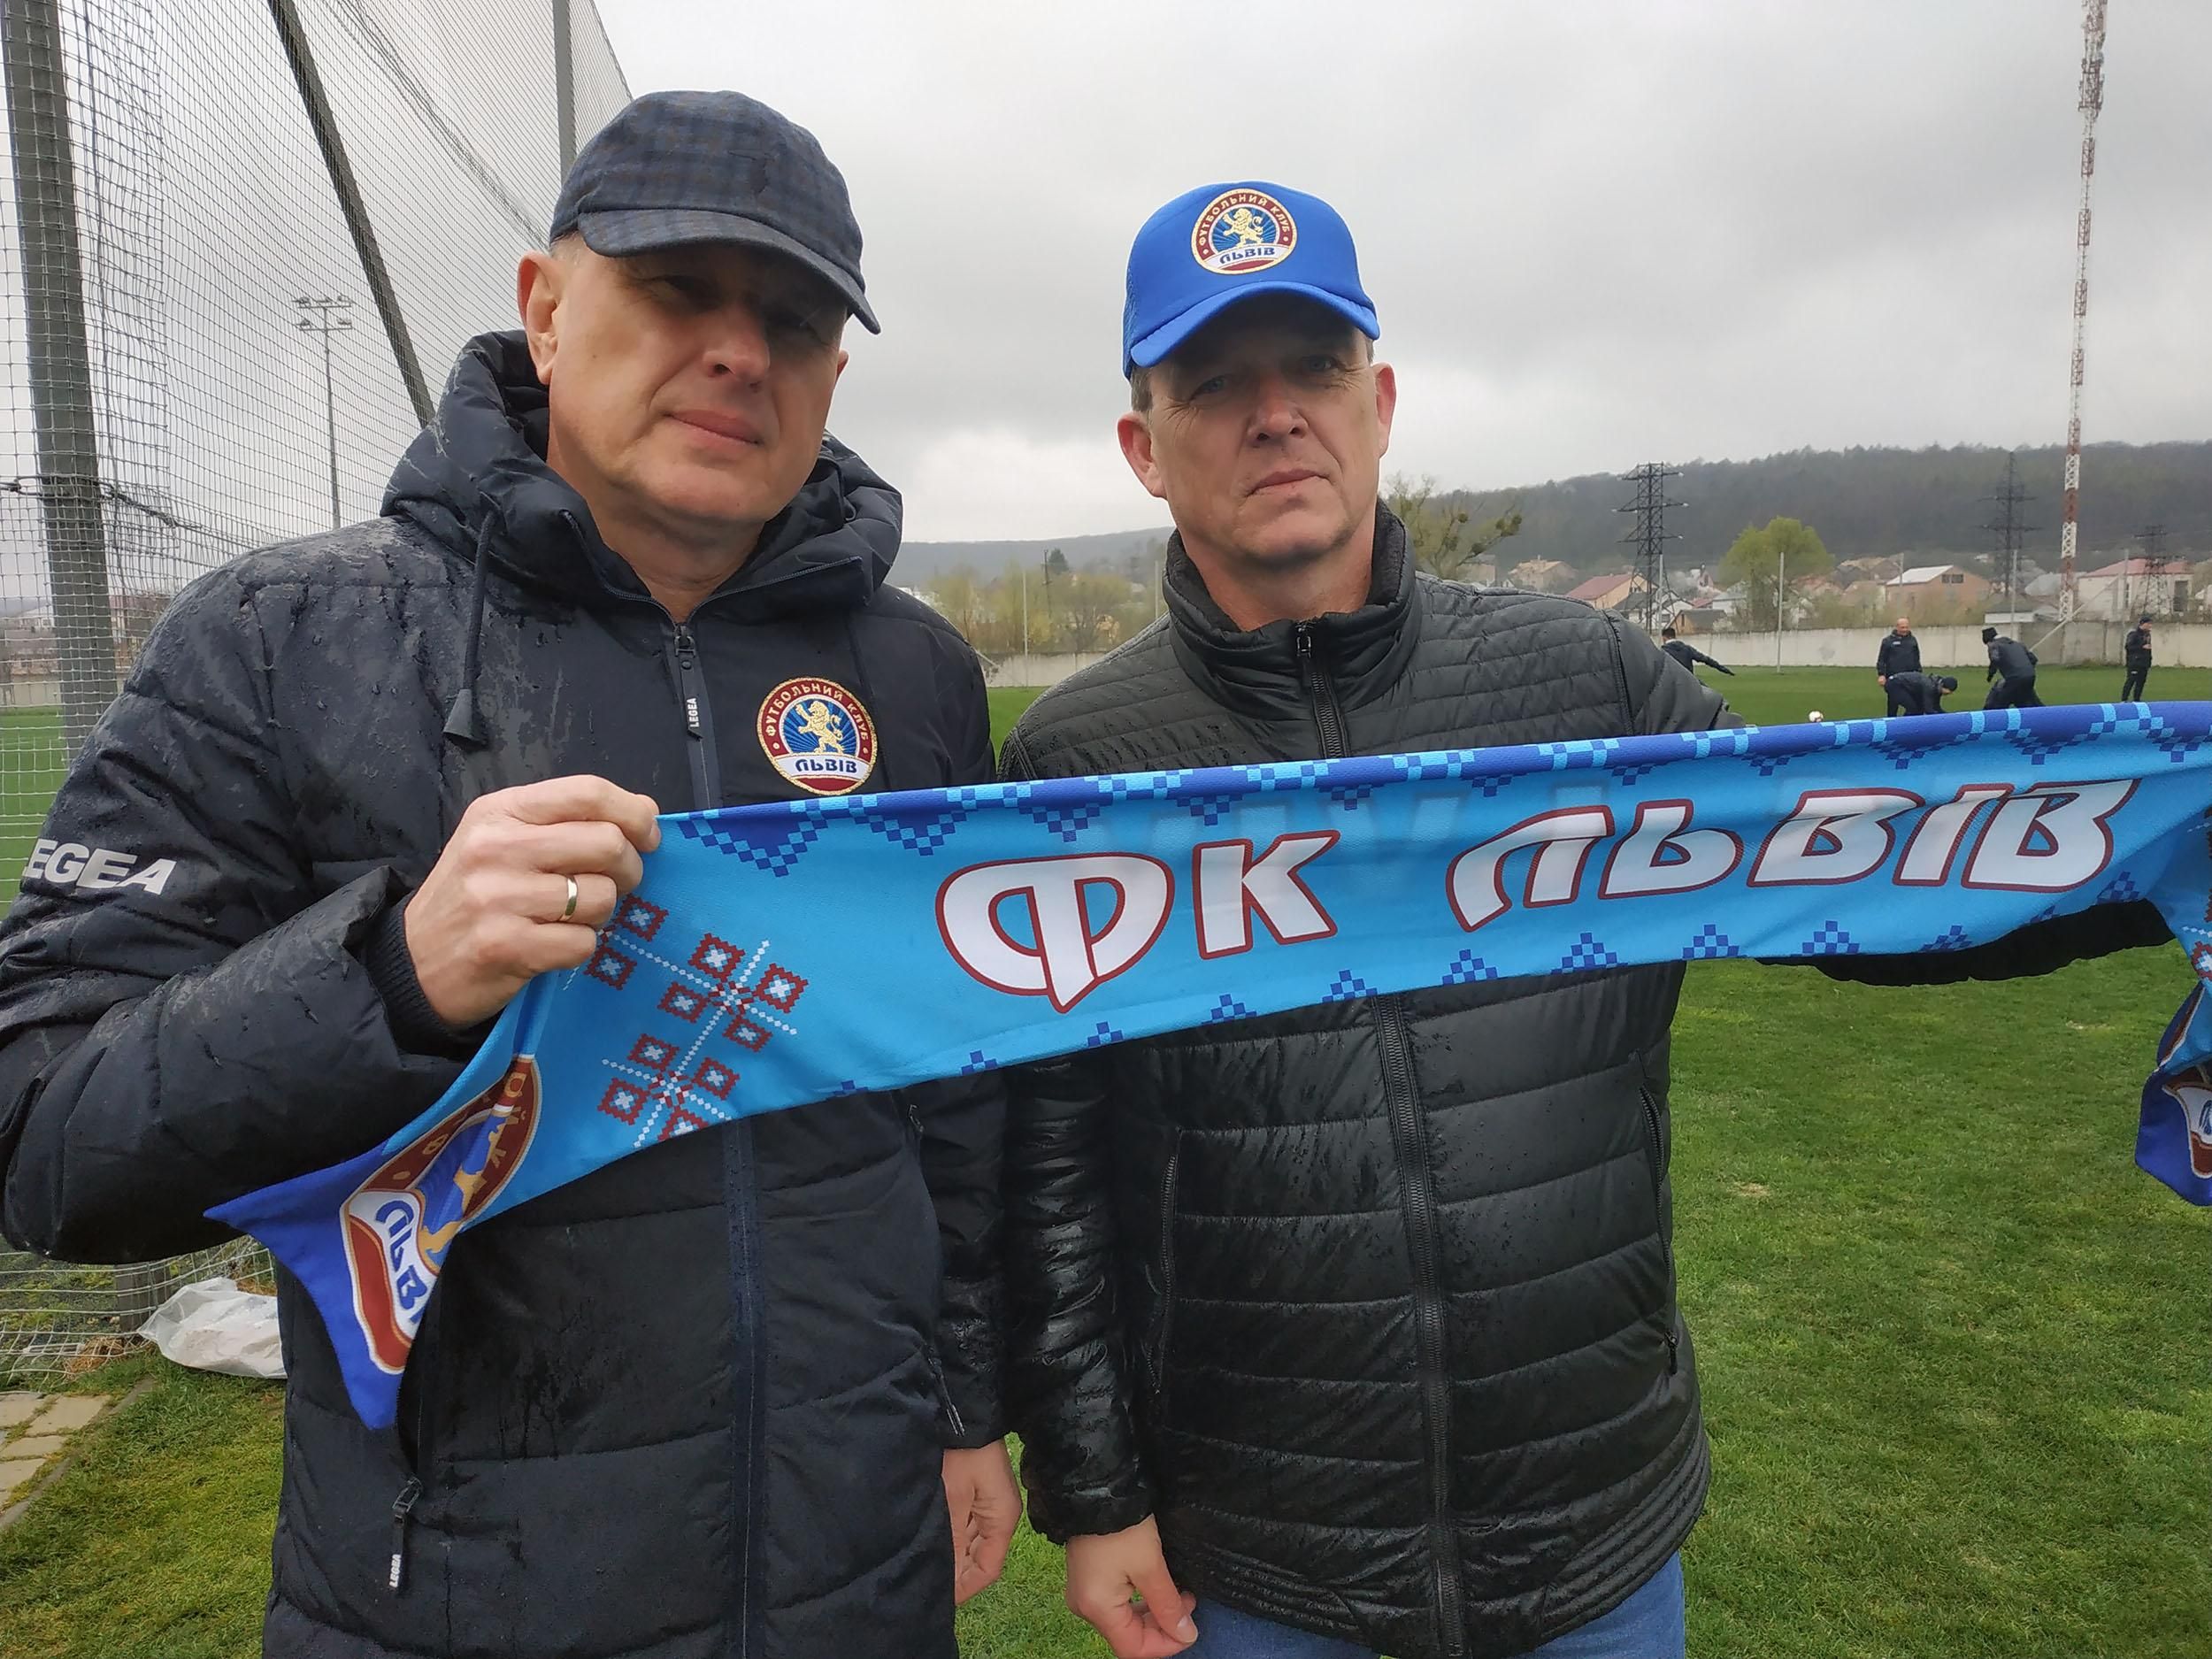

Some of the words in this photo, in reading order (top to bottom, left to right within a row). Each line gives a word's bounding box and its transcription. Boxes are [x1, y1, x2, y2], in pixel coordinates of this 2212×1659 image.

[1199, 194, 1268, 246] ФУТБОЛЬНИЙ
[1270, 205, 1290, 233] КЛУБ
[1219, 247, 1276, 265] ЛЬВІВ
[687, 697, 700, 727] LEGEA
[765, 682, 843, 737] ФУТБОЛЬНИЙ
[847, 703, 869, 741] КЛУБ
[795, 758, 857, 773] ЛЬВІВ
[22, 838, 177, 895] EGEA
[935, 829, 1340, 1014] ФК
[1445, 779, 2142, 933] ЛЬВІВ
